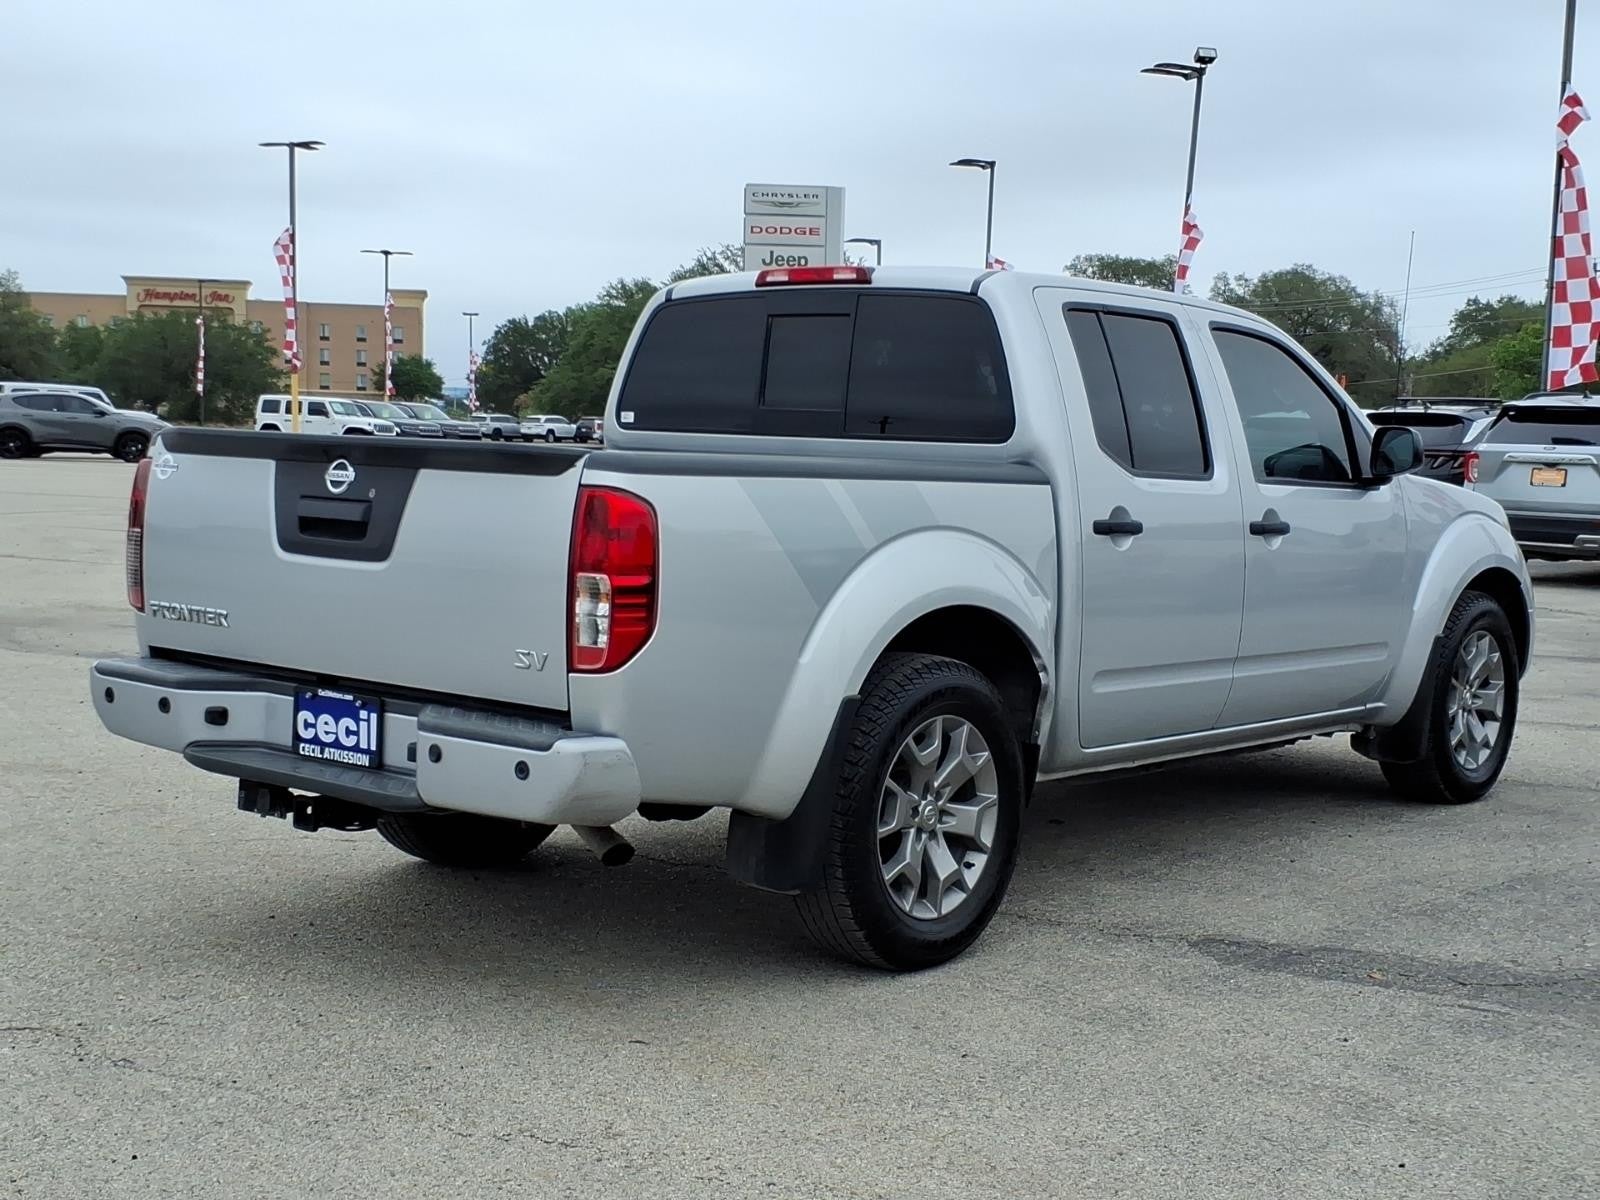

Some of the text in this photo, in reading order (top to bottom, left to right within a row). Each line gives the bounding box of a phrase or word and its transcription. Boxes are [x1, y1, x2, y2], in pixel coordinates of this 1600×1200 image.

[752, 191, 819, 199] CHRYSLER
[750, 225, 821, 236] DODGE
[761, 250, 809, 267] Jeep
[137, 288, 235, 304] Hampton Inn
[149, 600, 230, 627] FRONTIER
[513, 649, 549, 671] SV
[297, 710, 377, 751] cecil
[299, 743, 370, 767] CECIL ATKISSION
